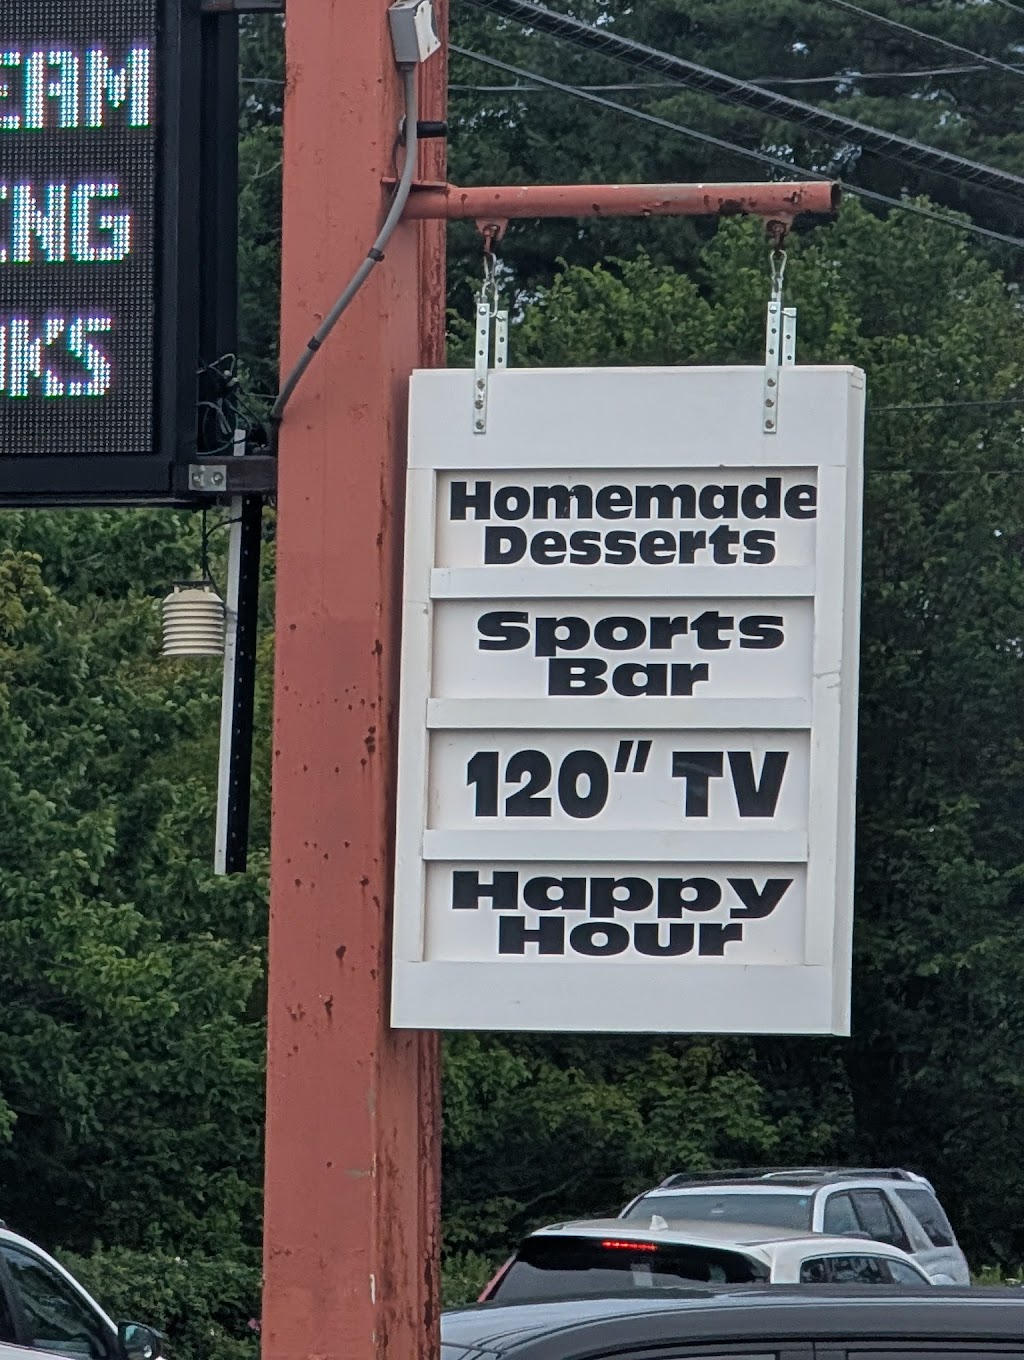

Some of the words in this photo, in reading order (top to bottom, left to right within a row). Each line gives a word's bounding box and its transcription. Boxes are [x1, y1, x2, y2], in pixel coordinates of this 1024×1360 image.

[449, 476, 818, 521] Homemade
[483, 524, 777, 566] Desserts
[477, 610, 785, 658] Sports
[547, 658, 709, 697] Bar
[465, 739, 653, 820] 120"
[672, 751, 789, 818] TV
[451, 869, 795, 919] Happy
[497, 915, 744, 957] Hour
